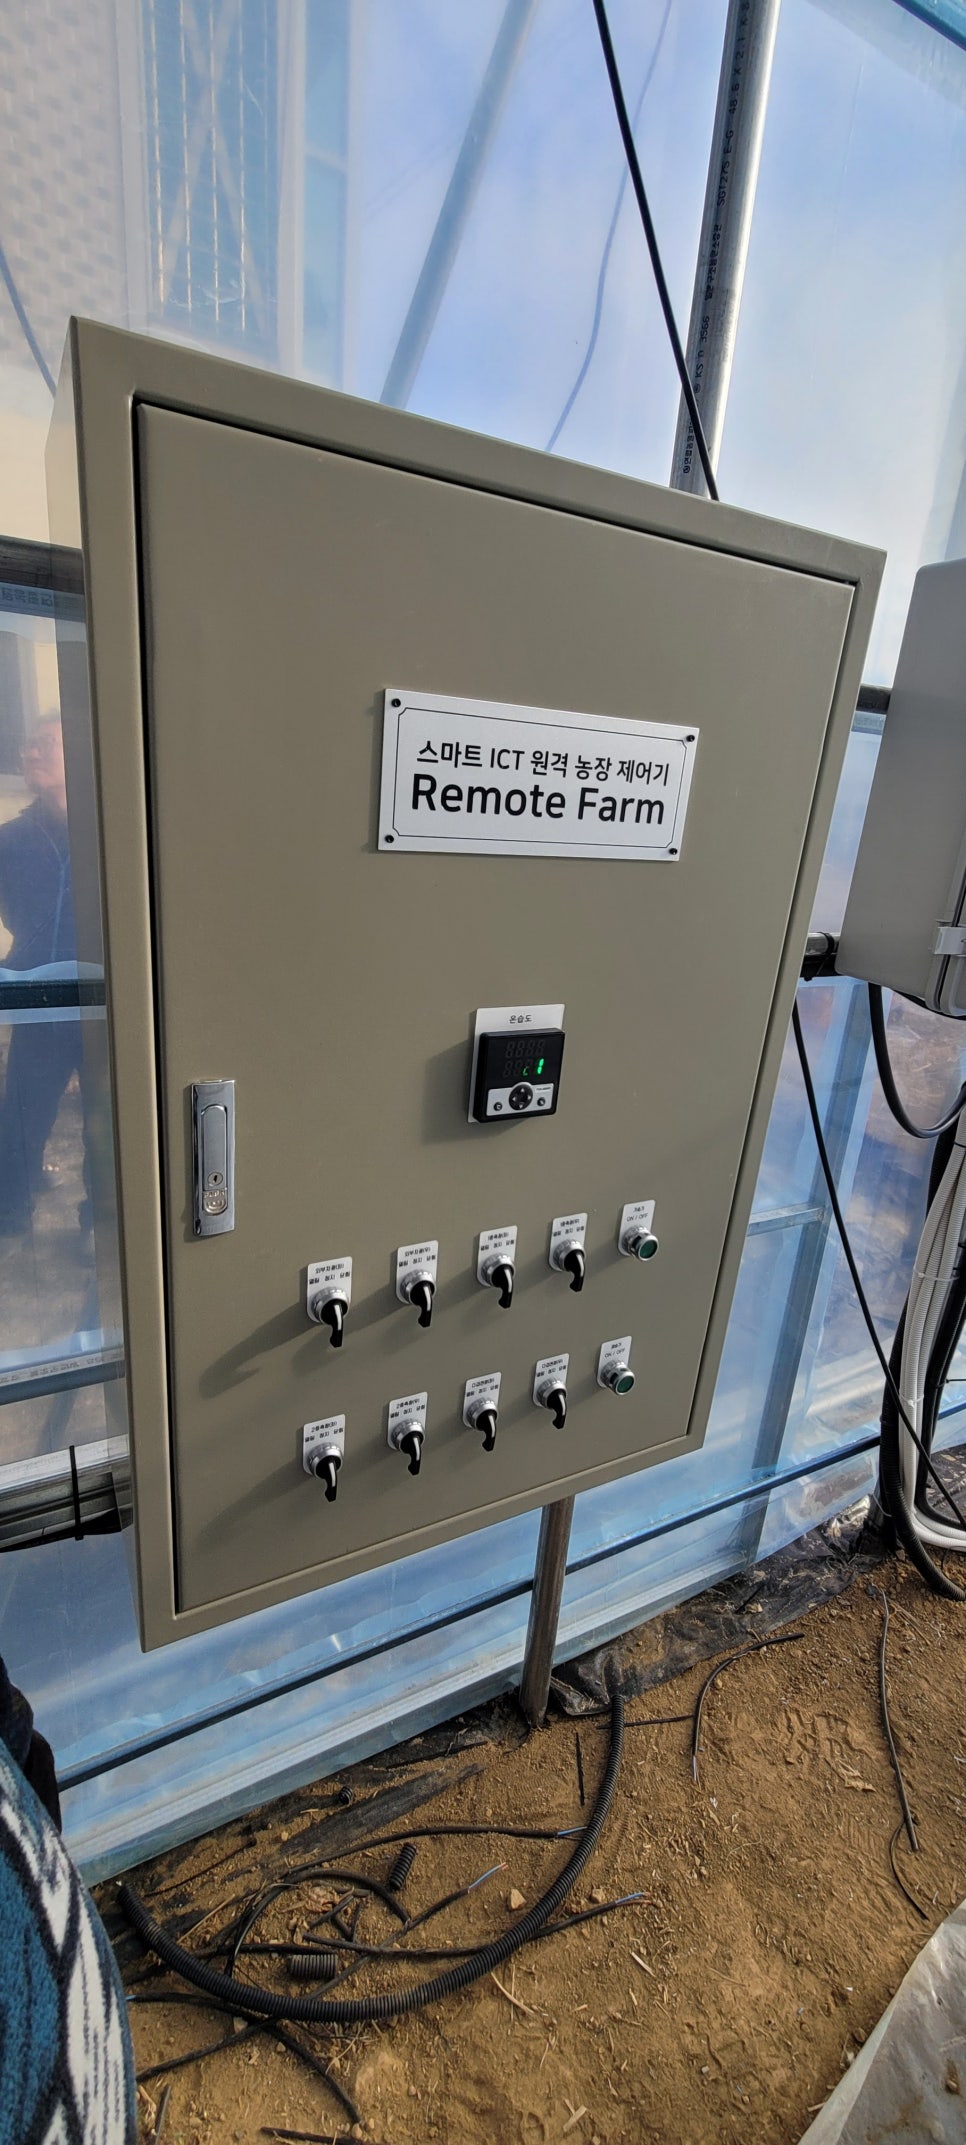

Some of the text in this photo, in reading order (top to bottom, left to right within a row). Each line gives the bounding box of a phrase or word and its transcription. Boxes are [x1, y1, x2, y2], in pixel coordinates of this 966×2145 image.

[728, 83, 741, 115] 48.6
[723, 130, 734, 154] E-G
[716, 160, 730, 206] SGT275
[699, 315, 710, 343] 3566
[417, 740, 670, 786] 스마트 ICT 원격 농장 제어기
[412, 773, 665, 825] Remote Farm
[508, 1014, 533, 1024] 온습도
